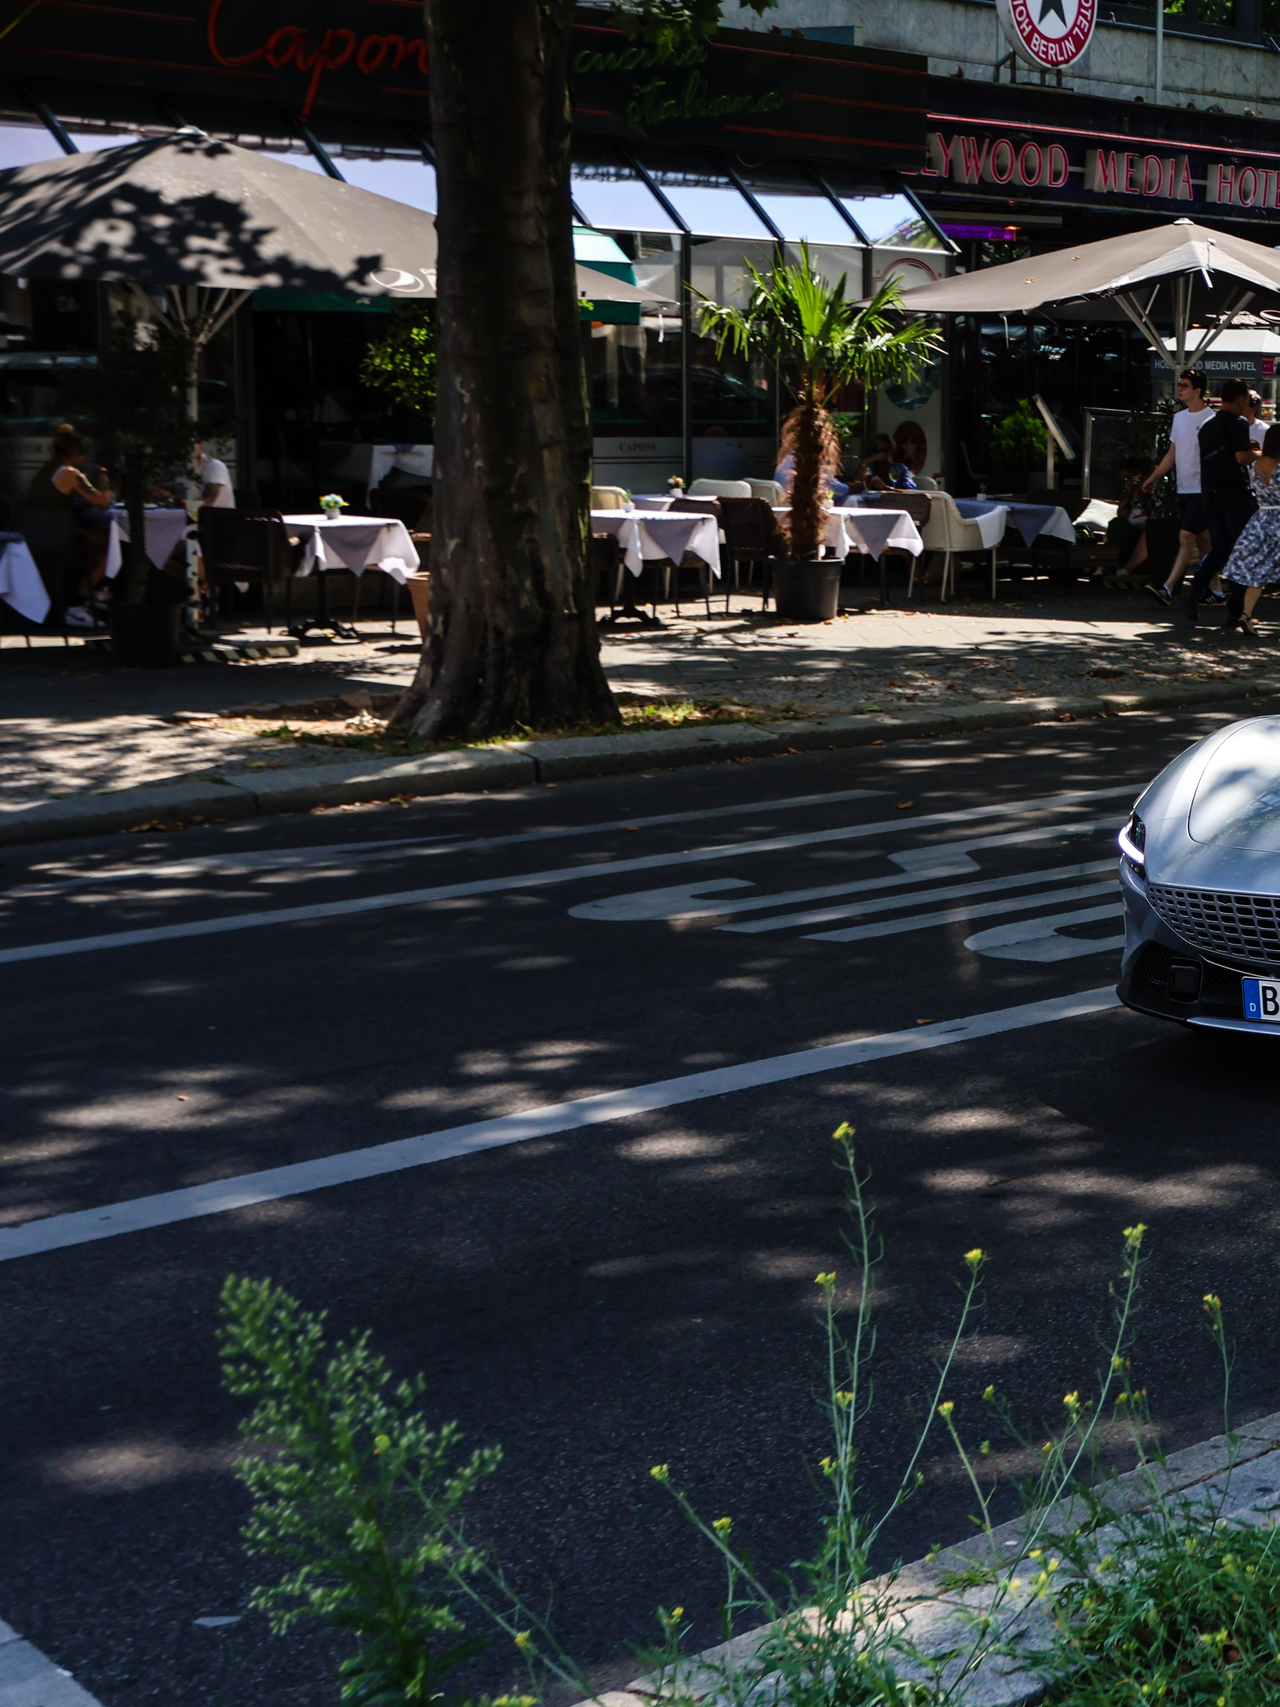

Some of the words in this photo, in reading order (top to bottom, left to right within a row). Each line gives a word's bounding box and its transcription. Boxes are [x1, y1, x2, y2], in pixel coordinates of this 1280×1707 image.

[1030, 32, 1076, 62] BERLIN
[1093, 148, 1193, 201] MEDIA
[1204, 361, 1230, 371] MEDIA
[1231, 361, 1257, 372] HOTEL
[1261, 985, 1280, 1016] B
